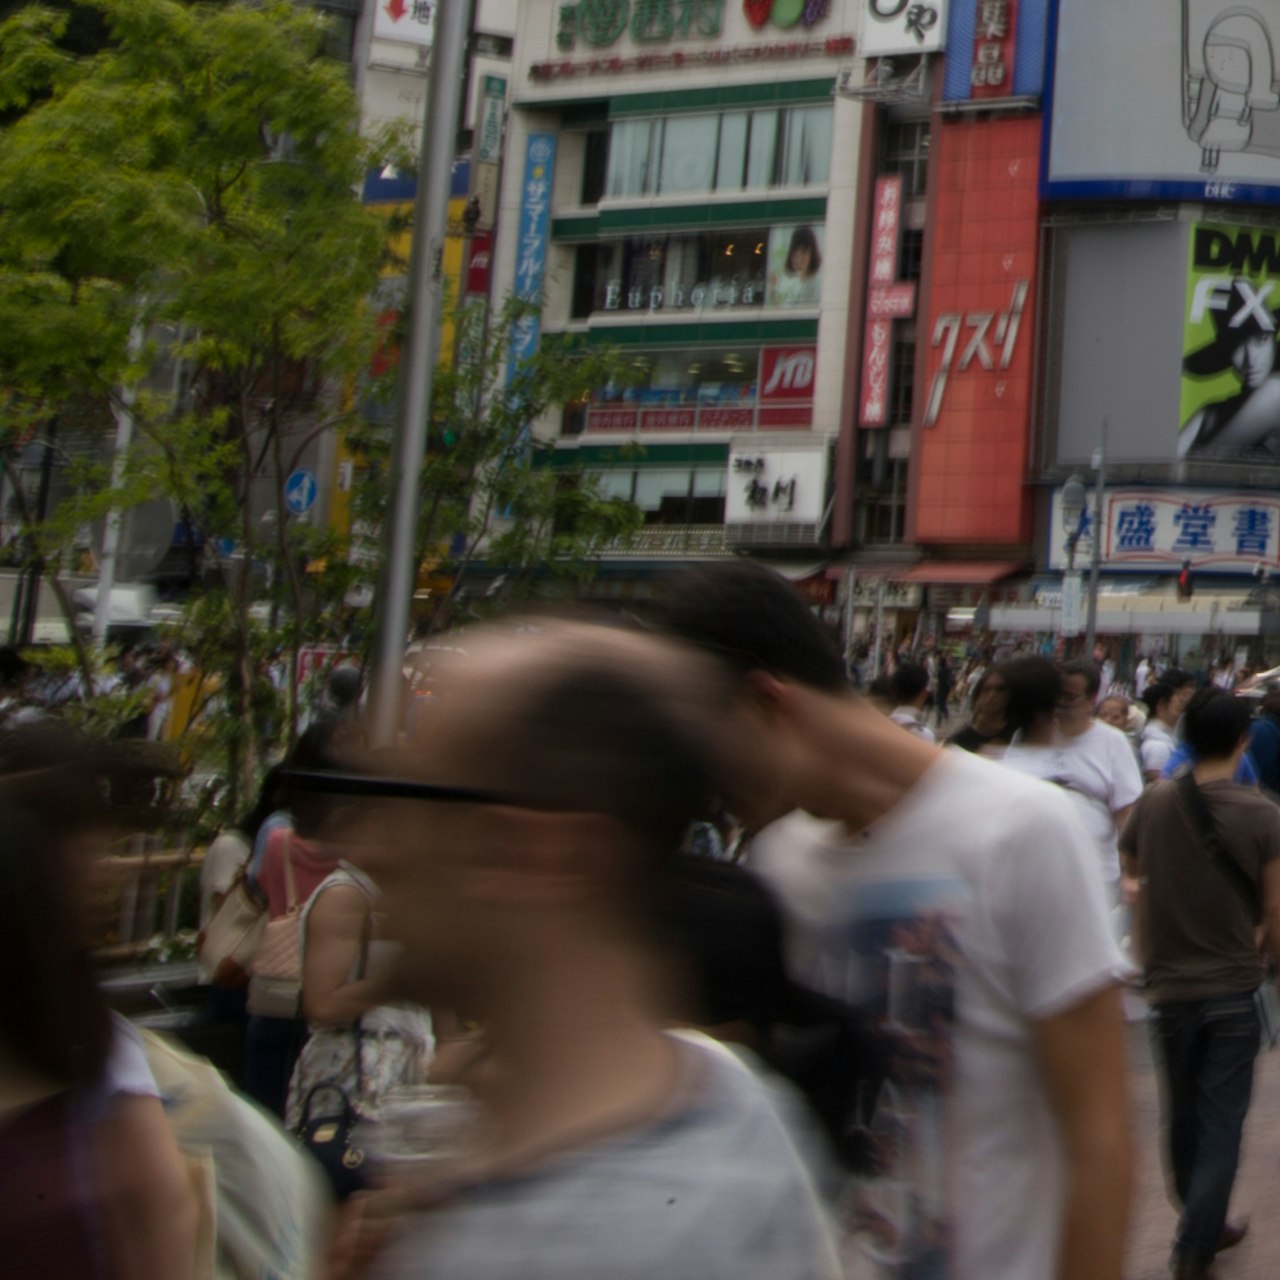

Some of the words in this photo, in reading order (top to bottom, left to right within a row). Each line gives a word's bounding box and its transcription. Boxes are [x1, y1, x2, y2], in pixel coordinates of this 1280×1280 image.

[1203, 179, 1237, 200] DHC
[602, 276, 758, 316] Euphoria
[1188, 274, 1279, 332] FX
[763, 350, 815, 396] JTB
[920, 276, 1030, 429] クスリ
